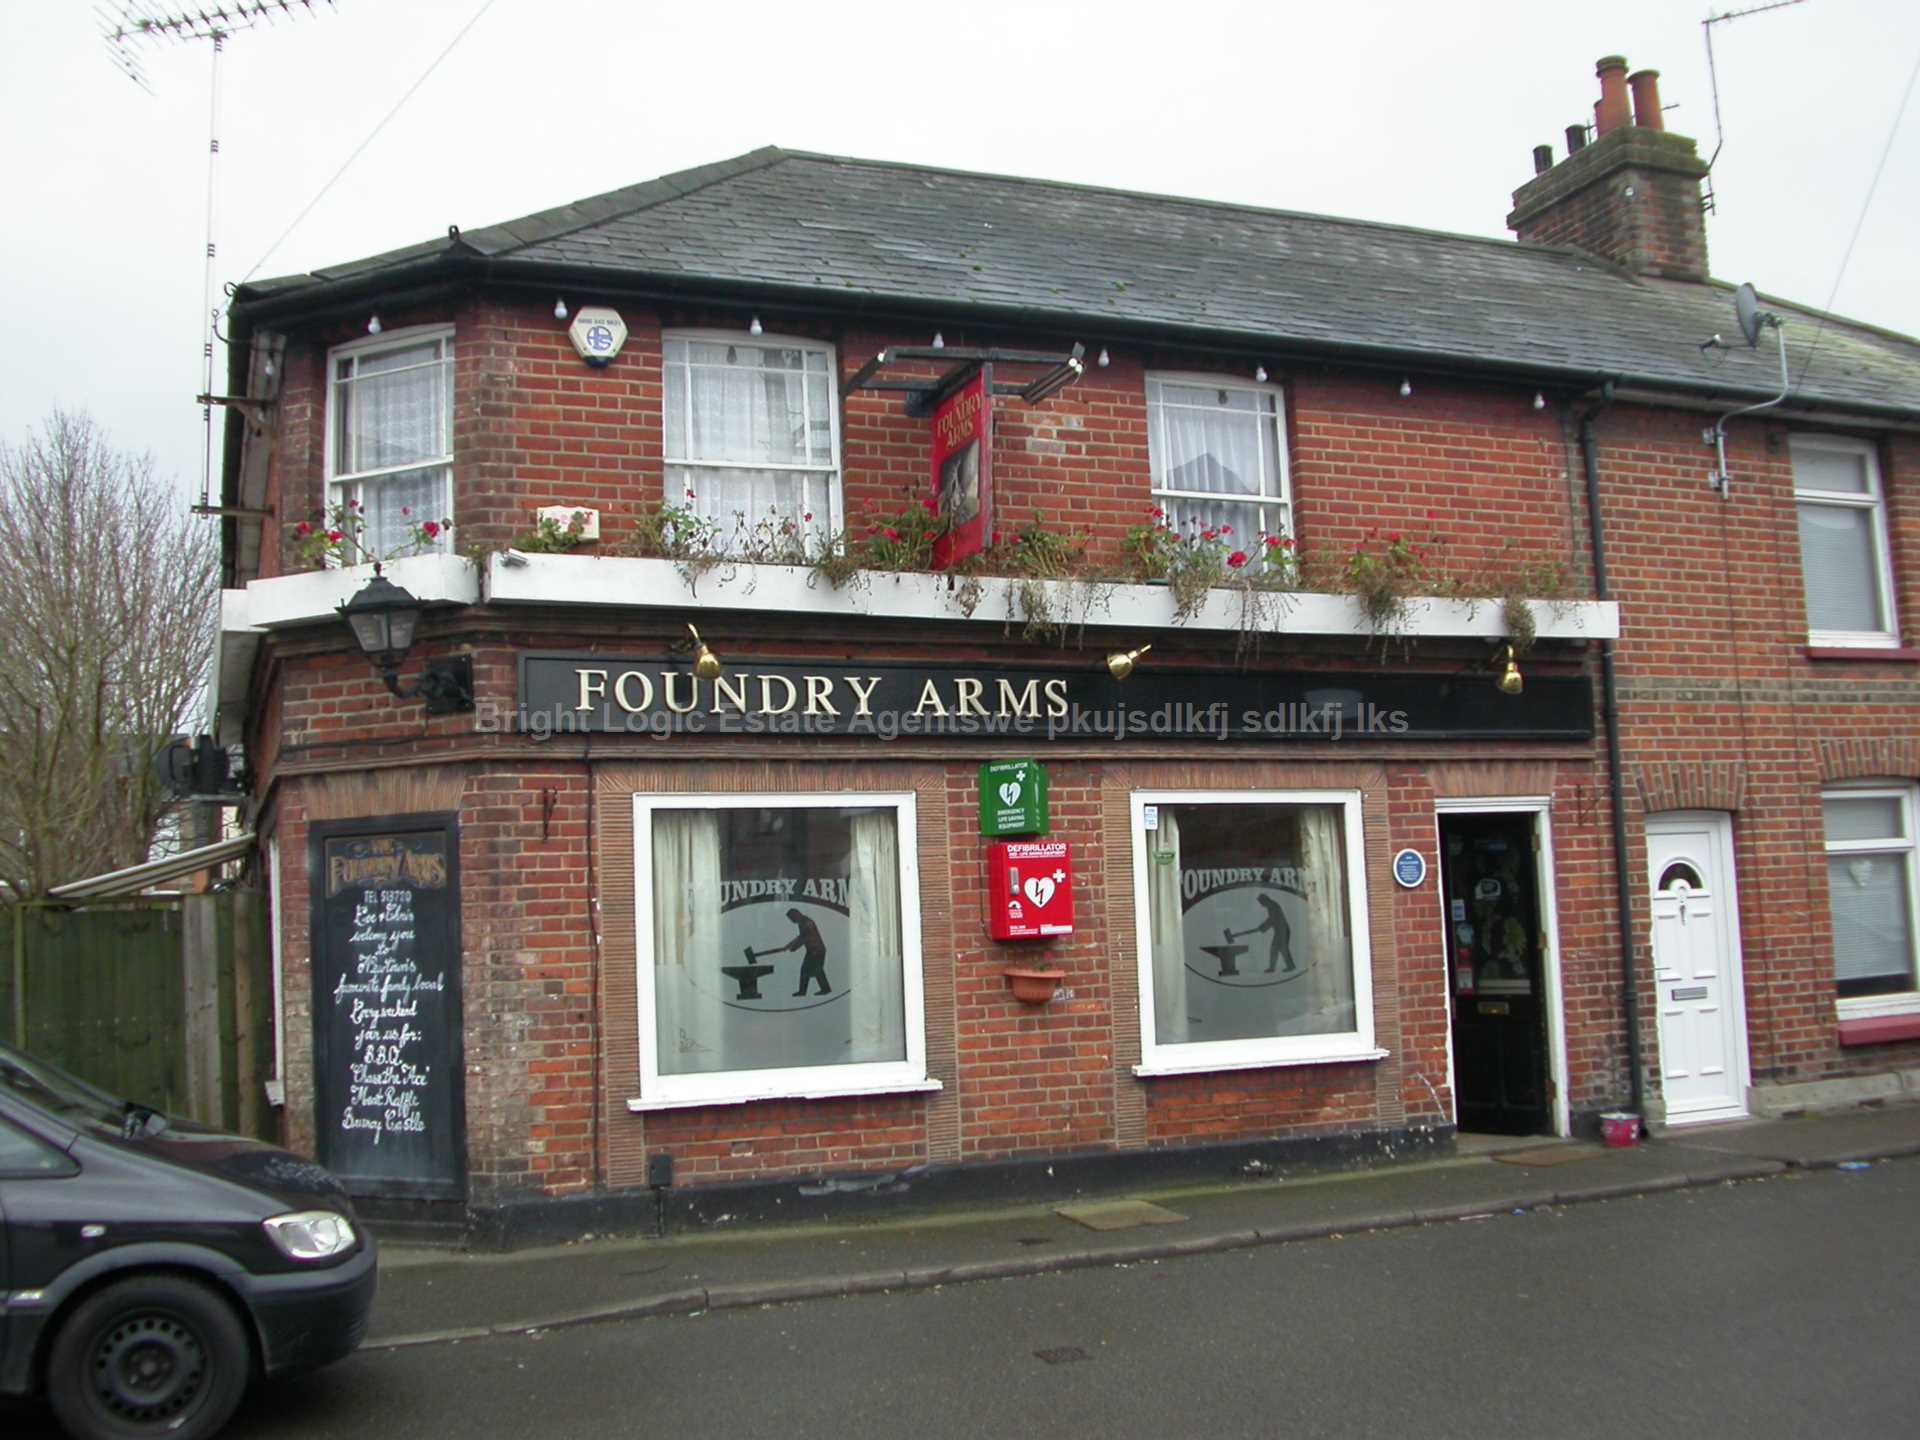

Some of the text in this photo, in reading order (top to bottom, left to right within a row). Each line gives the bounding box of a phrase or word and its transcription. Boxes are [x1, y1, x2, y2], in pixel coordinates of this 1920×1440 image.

[937, 393, 981, 438] FOUNDRY
[946, 419, 973, 448] ARMS
[575, 669, 1068, 718] FOUNDRY ARMS
[1007, 843, 1066, 853] DEFIBRILLATOR
[1180, 867, 1265, 899] OUNDRY
[389, 929, 416, 951] you
[412, 972, 444, 991] local
[384, 1109, 425, 1132] Castle
